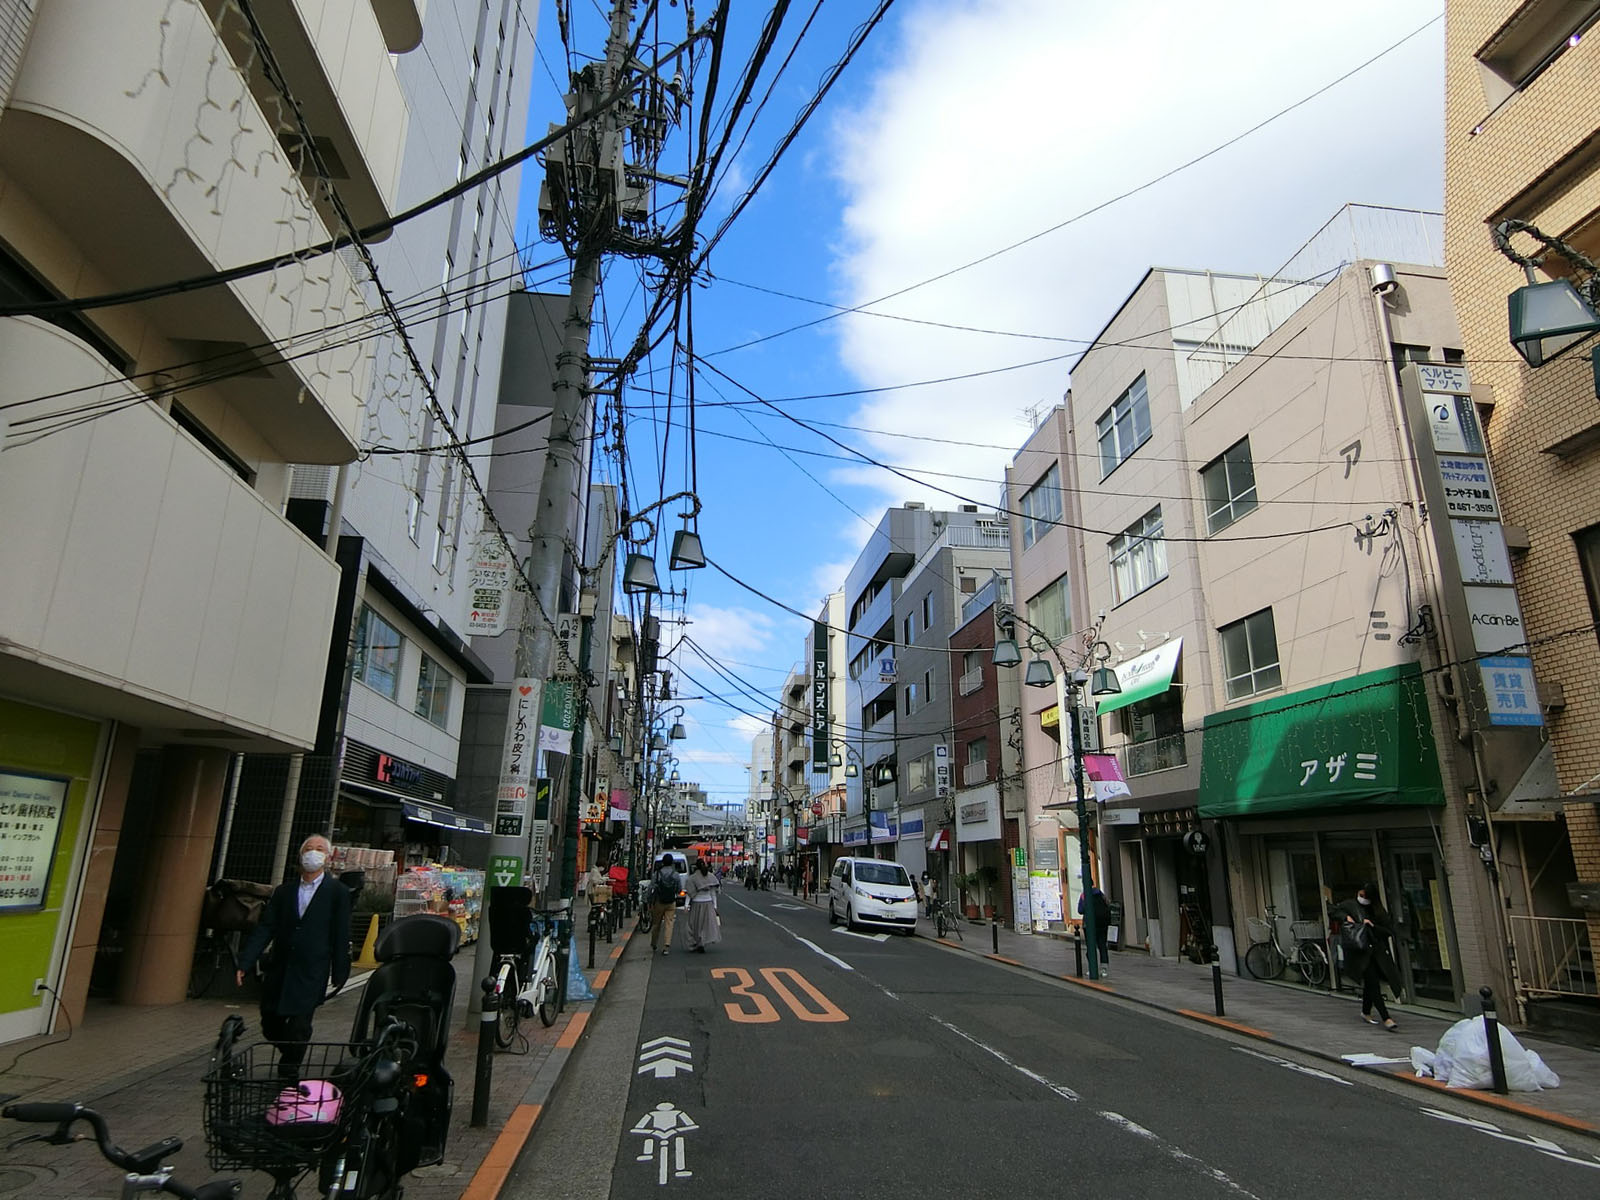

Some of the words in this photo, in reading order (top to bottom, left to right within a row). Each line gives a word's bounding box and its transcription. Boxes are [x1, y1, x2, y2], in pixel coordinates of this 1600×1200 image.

[1425, 378, 1463, 391] マツヤ
[1444, 487, 1491, 500] まつや不動産
[471, 578, 509, 588] クリニック
[1492, 672, 1524, 689] 賃貸
[814, 661, 827, 731] マルマンストア
[1496, 692, 1529, 709] 売買
[562, 708, 572, 729] 2020
[509, 698, 530, 776] にしかわ皮フ科
[1300, 752, 1378, 786] アザミ
[1143, 809, 1193, 824] CACAO
[1144, 822, 1194, 834] STORE
[710, 967, 850, 1023] 30
